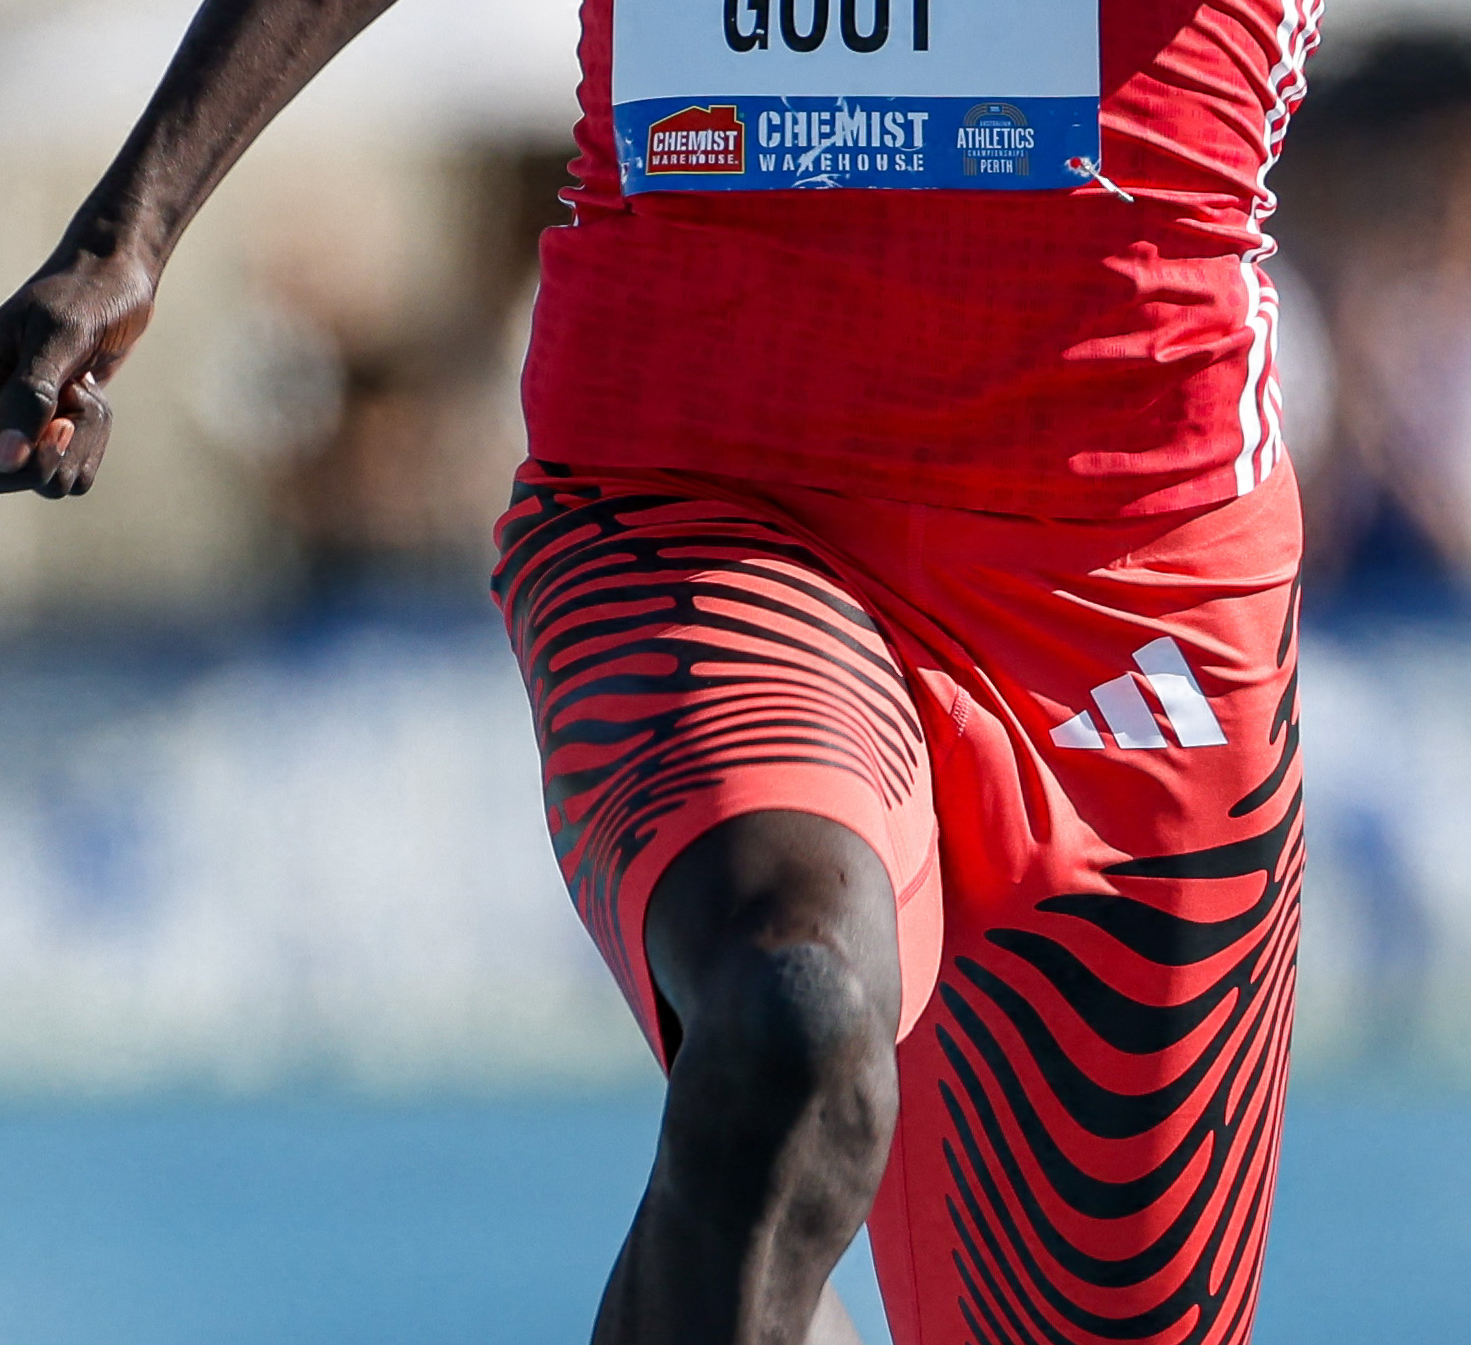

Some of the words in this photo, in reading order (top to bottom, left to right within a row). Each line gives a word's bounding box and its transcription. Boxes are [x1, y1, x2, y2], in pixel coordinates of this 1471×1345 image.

[653, 129, 738, 152] CHEMIST
[758, 111, 929, 148] CHEMIST
[956, 127, 1035, 149] ATHLETICS
[980, 159, 1014, 173] PERTH
